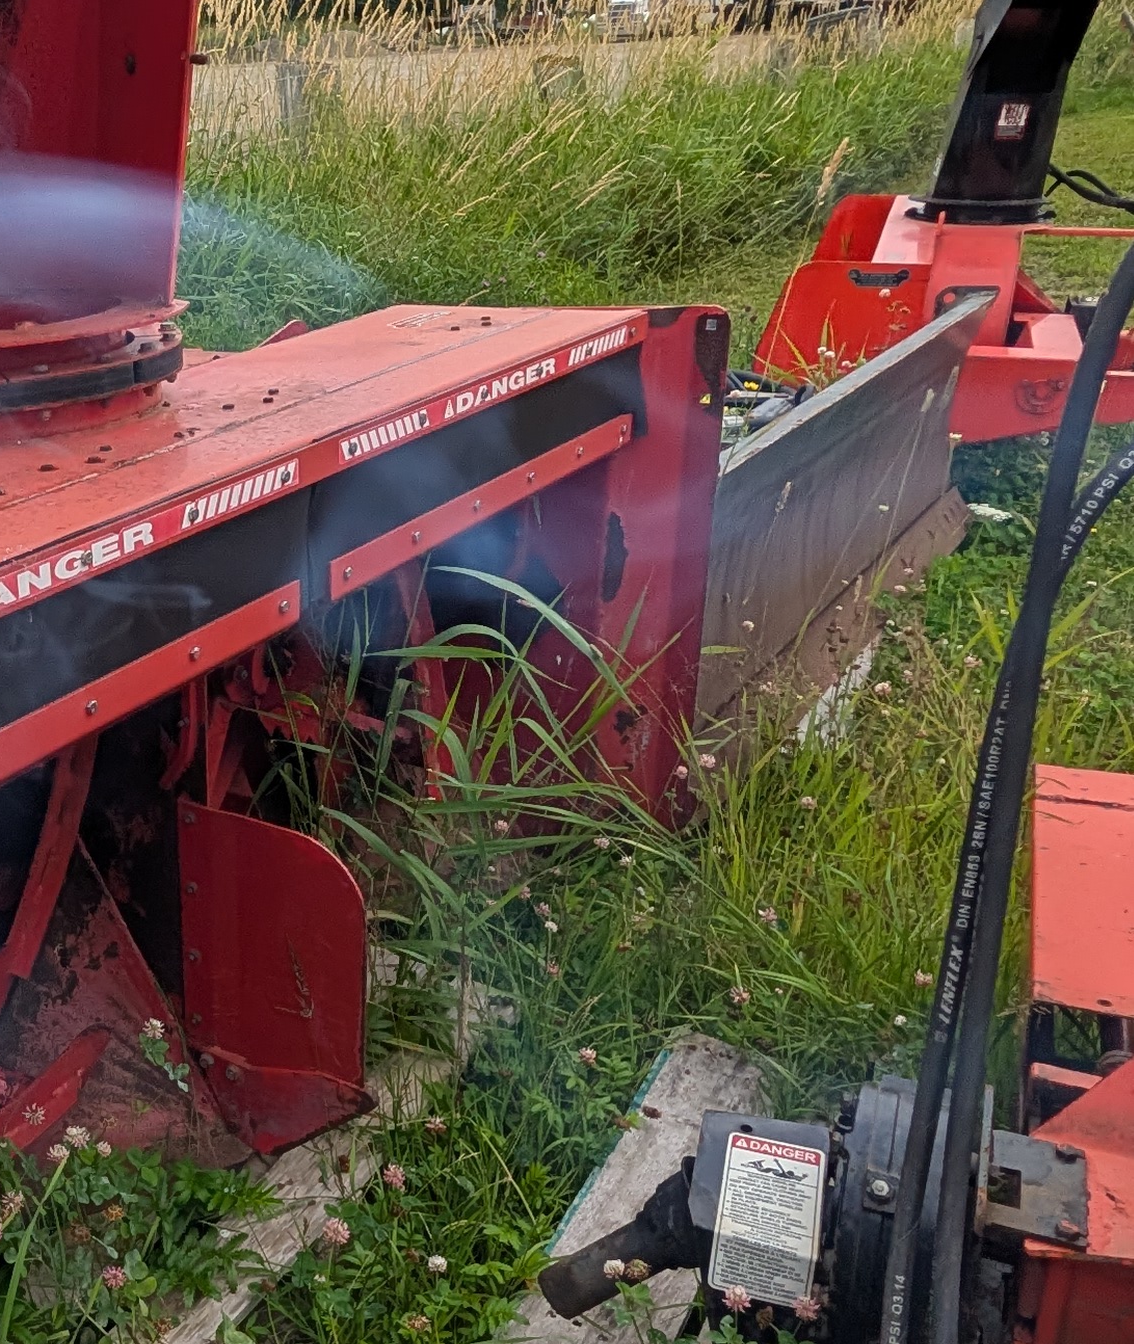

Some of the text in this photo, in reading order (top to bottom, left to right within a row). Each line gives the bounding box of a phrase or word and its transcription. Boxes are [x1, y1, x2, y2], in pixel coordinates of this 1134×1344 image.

[456, 357, 555, 413] DANGER
[1069, 500, 1098, 534] 5710
[1094, 473, 1119, 498] PSI
[955, 904, 971, 929] DIN
[749, 1140, 817, 1163] DANGER
[891, 1275, 906, 1316] Q3.14
